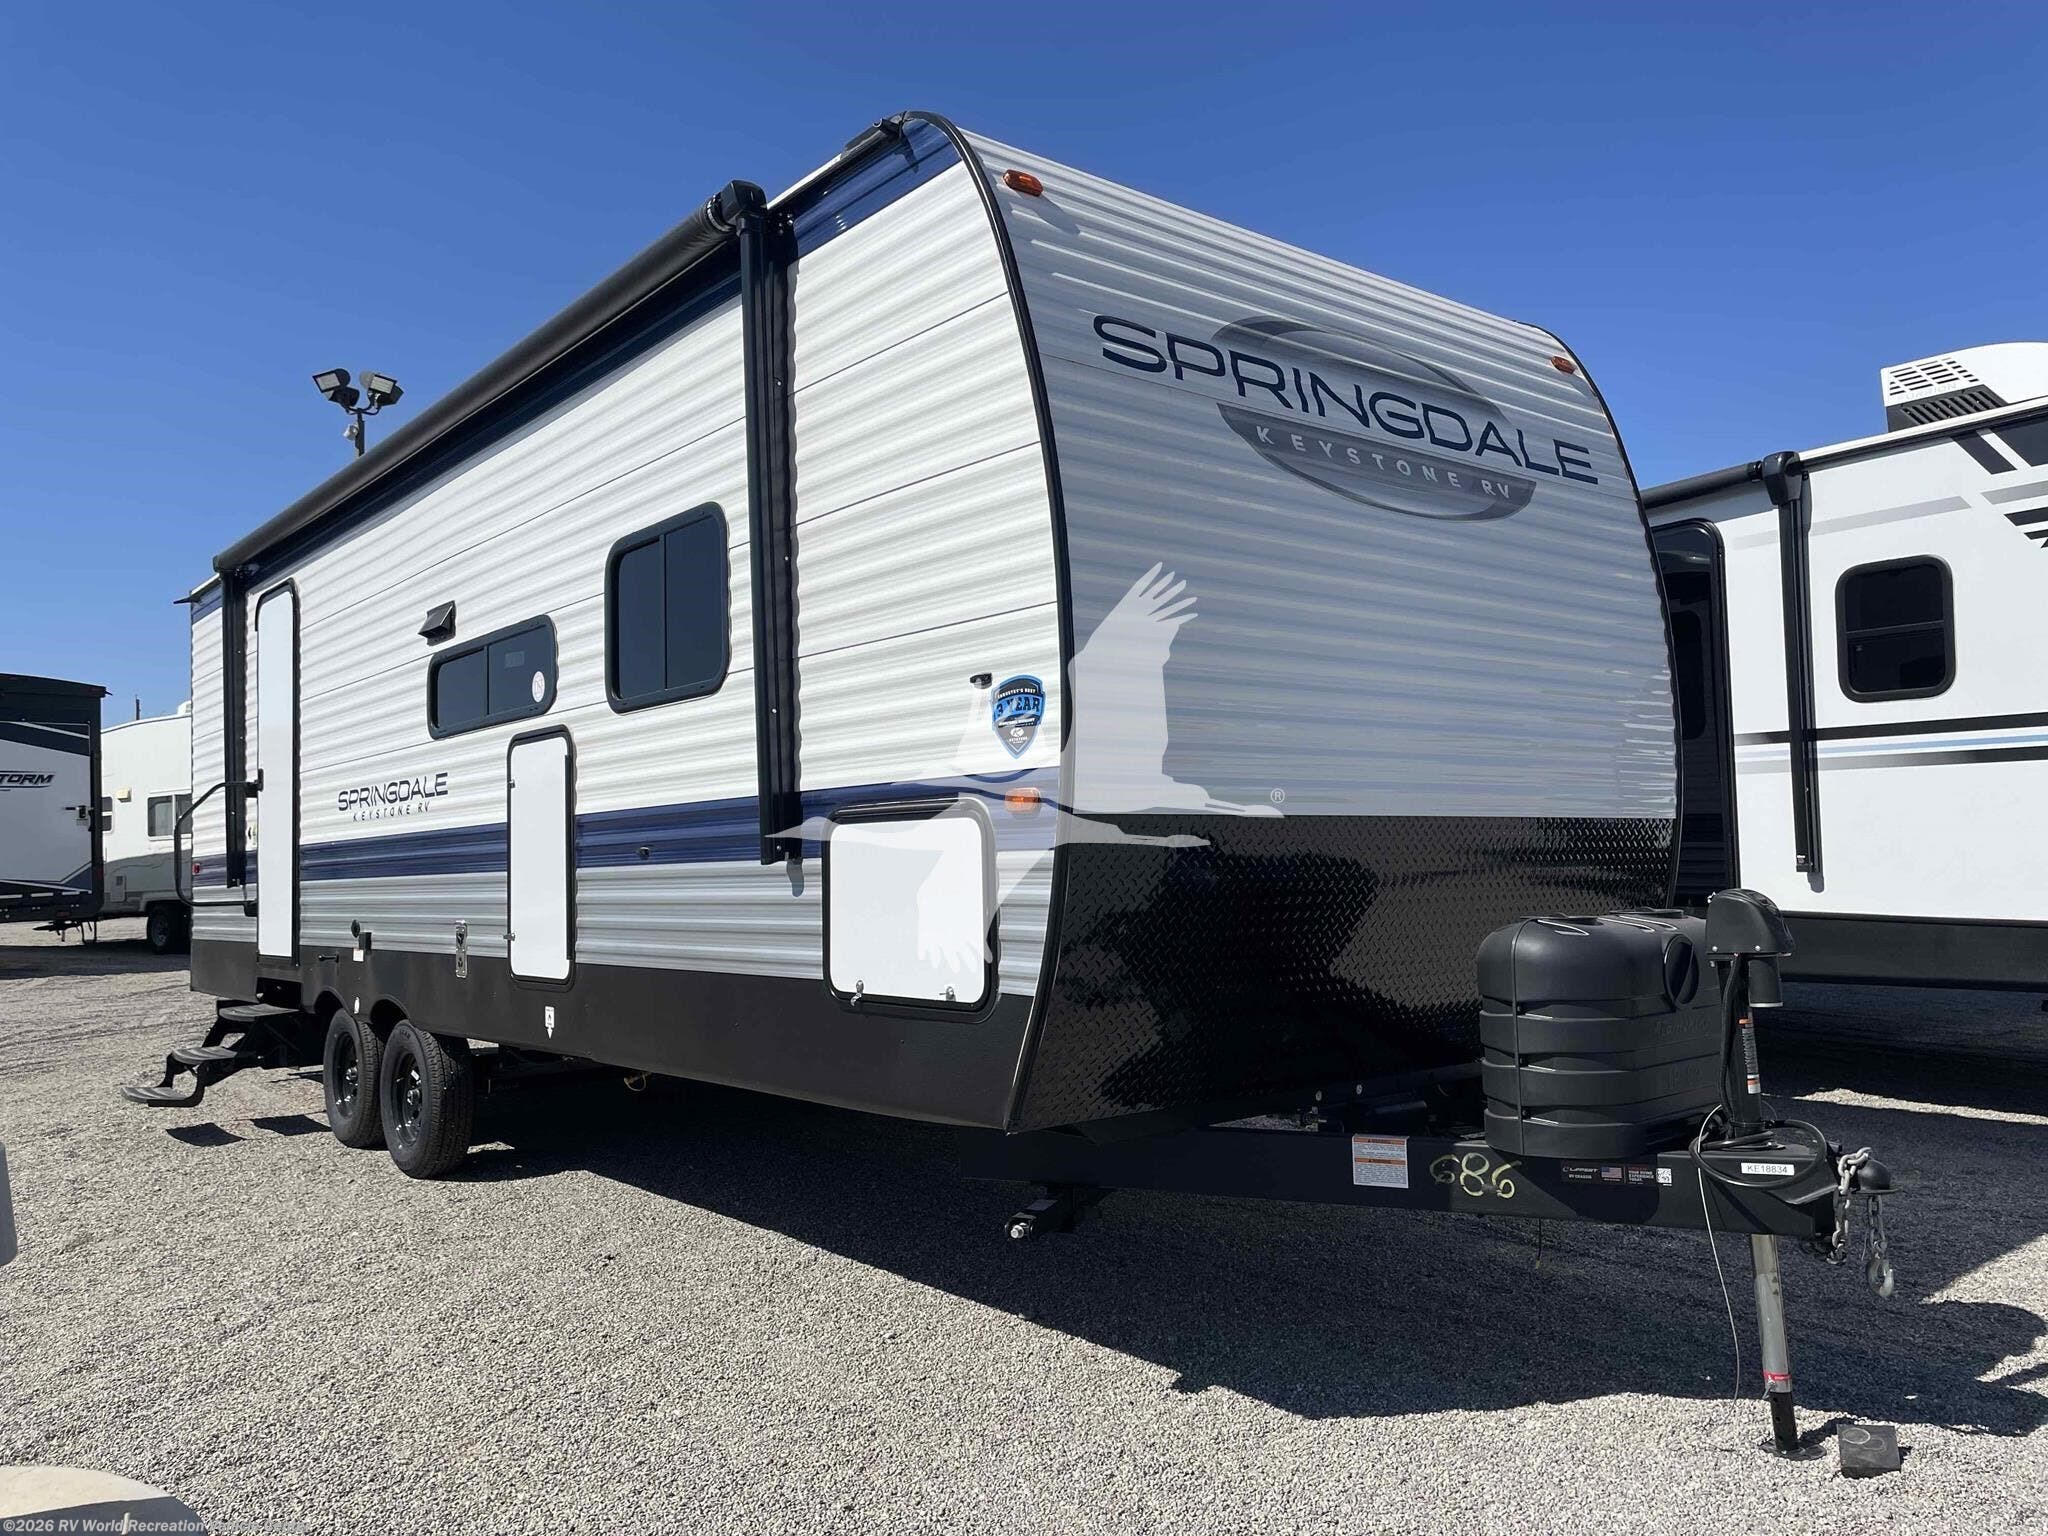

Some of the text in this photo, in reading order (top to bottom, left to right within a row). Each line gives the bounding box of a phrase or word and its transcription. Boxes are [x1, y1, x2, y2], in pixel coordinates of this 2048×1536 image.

[1093, 315, 1598, 485] SPRINGDALE
[1256, 424, 1511, 499] KEYSTONE RV
[1007, 696, 1041, 712] YEAR
[338, 772, 448, 811] SPRINGDALE
[353, 801, 430, 822] KEYSTONE RV
[1429, 1152, 1522, 1199] 686
